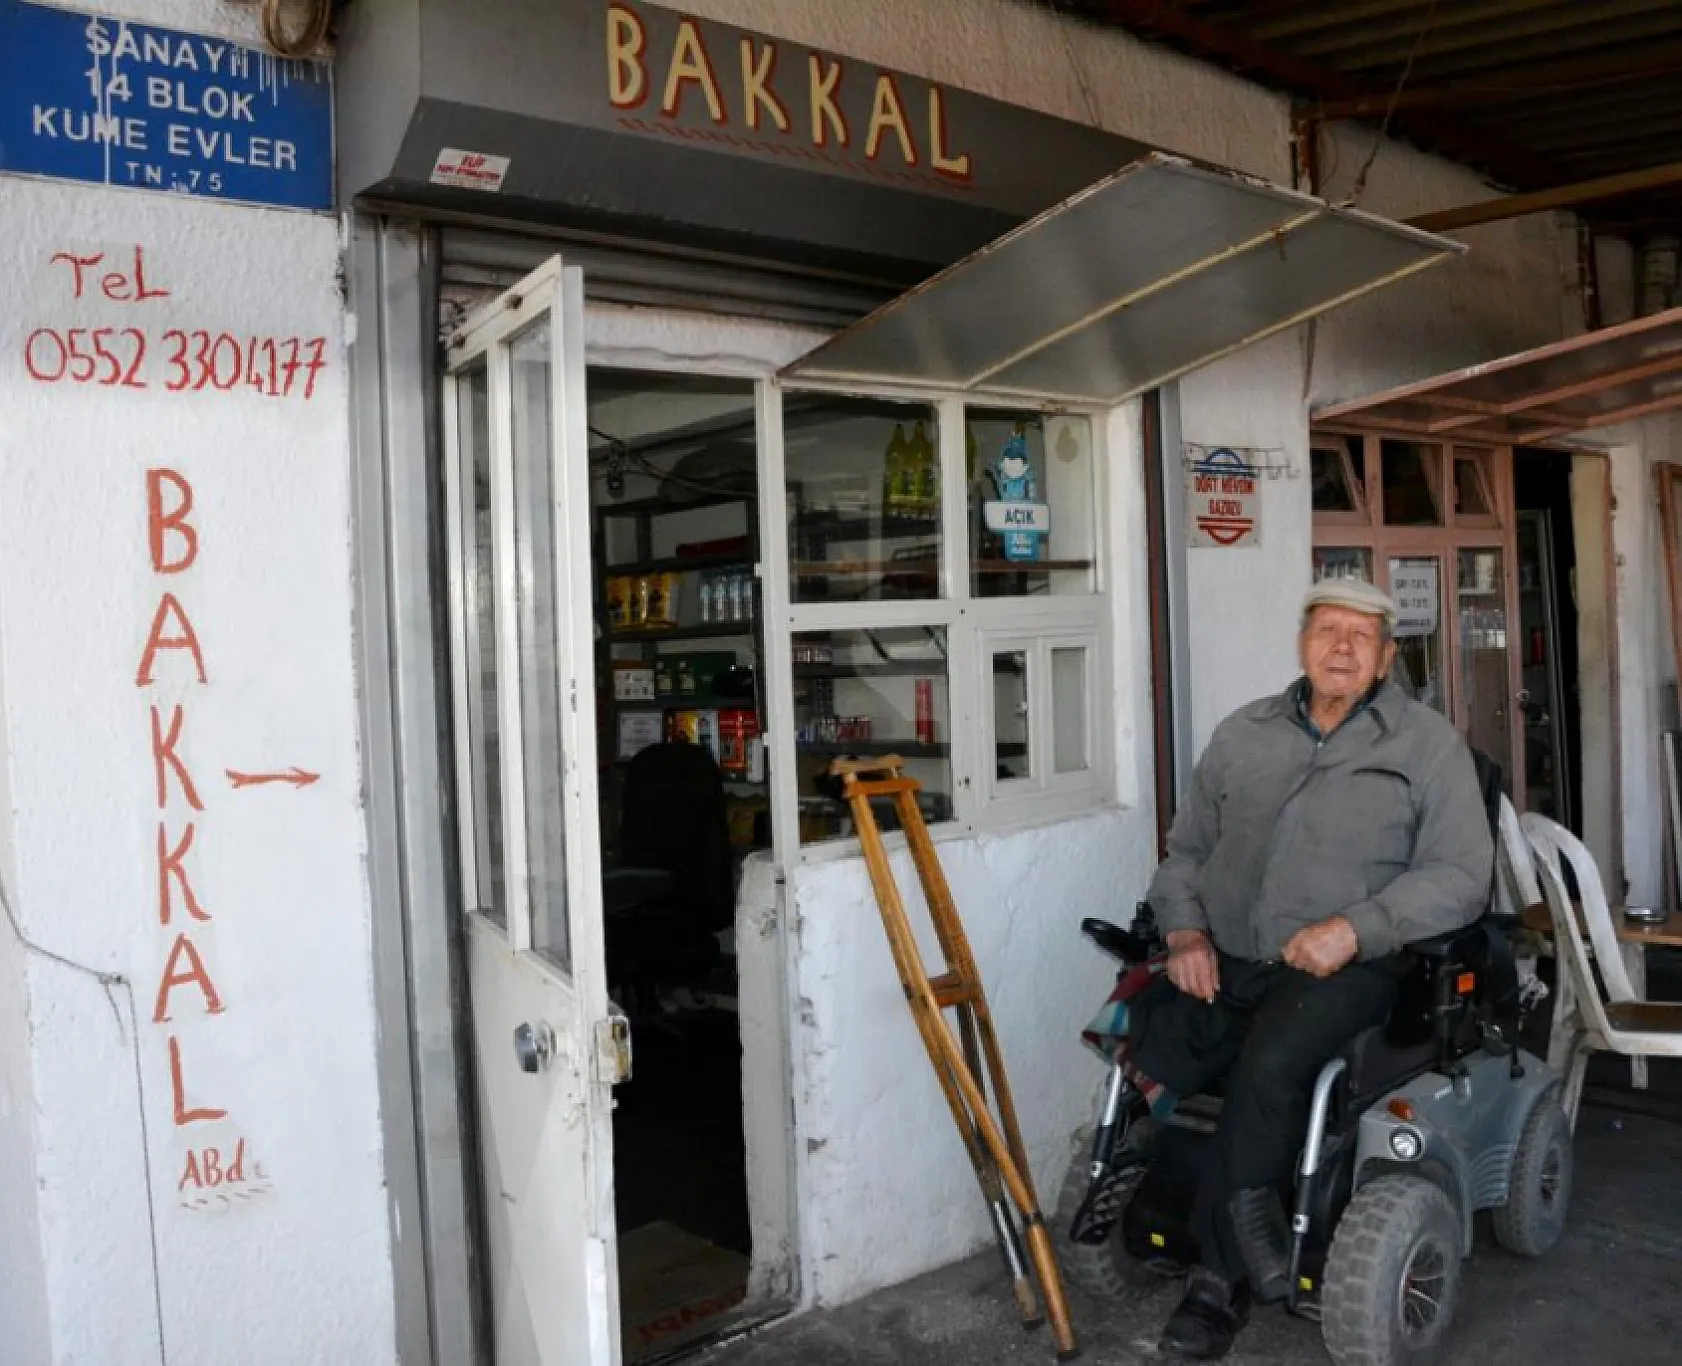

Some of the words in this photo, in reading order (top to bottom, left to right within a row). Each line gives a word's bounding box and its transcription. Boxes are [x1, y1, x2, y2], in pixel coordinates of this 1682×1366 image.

[84, 67, 133, 102] 14
[147, 75, 255, 122] BLOK
[607, 3, 970, 179] BAKKAL
[167, 123, 297, 171] EVLER
[24, 327, 148, 389] 0552
[162, 328, 328, 400] 3304177
[135, 467, 229, 1126] BAKKAL
